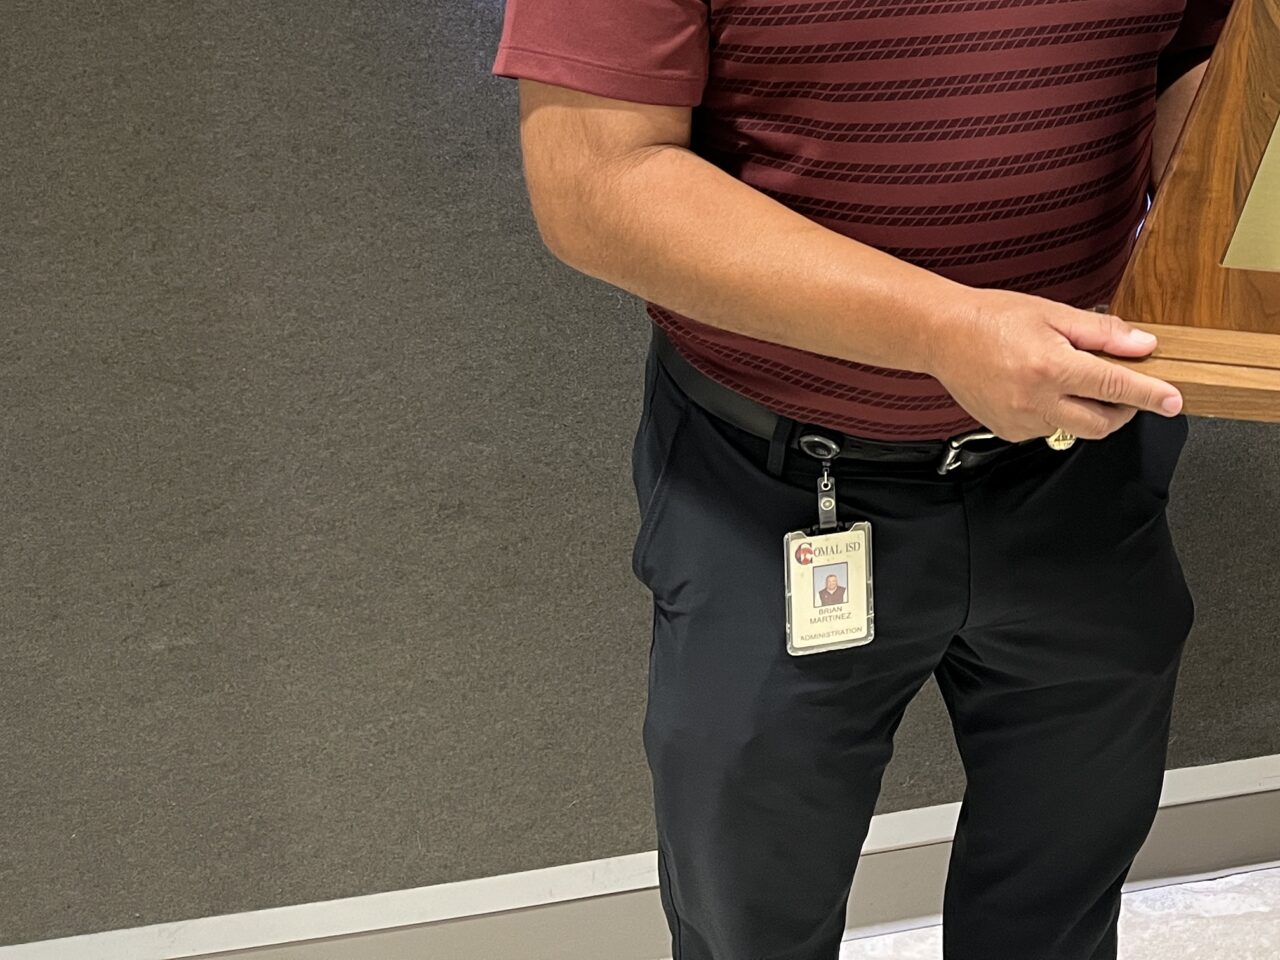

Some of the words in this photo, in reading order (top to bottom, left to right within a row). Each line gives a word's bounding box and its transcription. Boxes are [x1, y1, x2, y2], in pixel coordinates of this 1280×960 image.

[795, 542, 842, 565] COMAL
[845, 541, 861, 553] ISD
[818, 606, 843, 616] BRIAN
[809, 612, 852, 625] MARTINEZ
[800, 626, 863, 641] ADMINISTRATION
